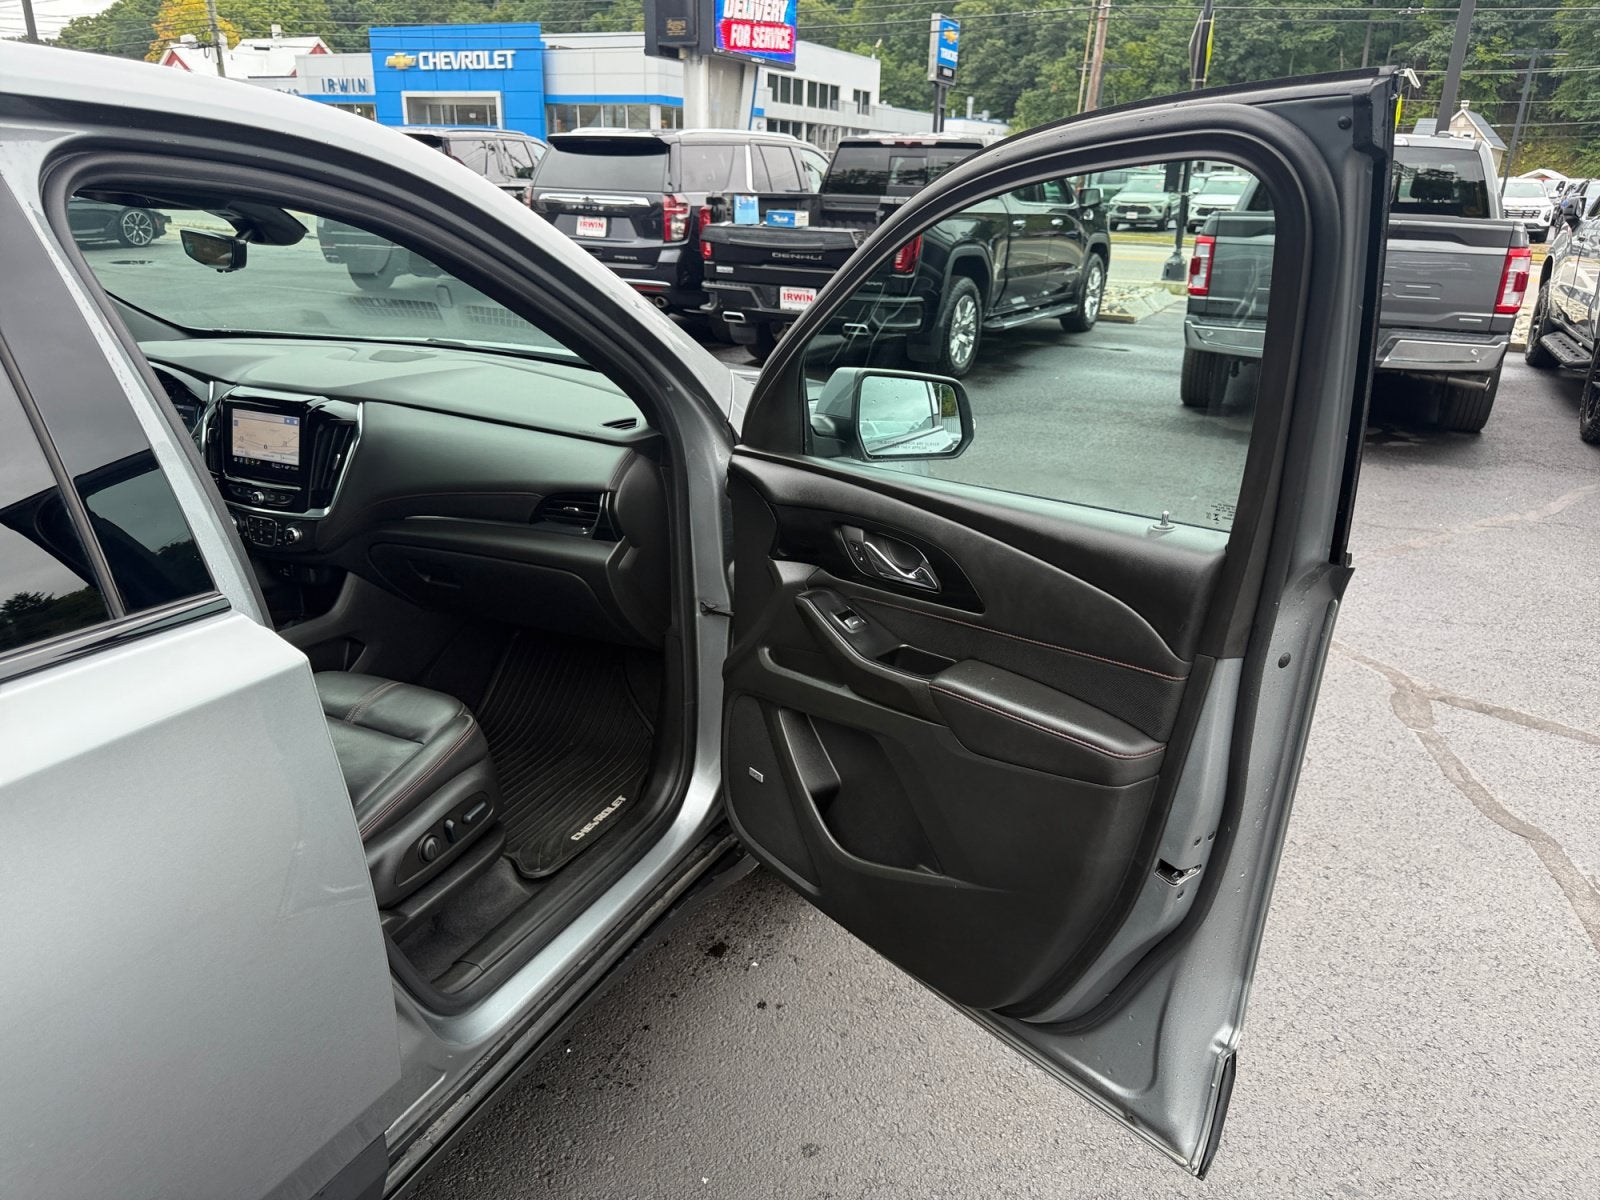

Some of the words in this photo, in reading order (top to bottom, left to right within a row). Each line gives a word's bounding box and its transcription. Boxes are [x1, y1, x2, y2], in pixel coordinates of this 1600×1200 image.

[723, 0, 789, 23] DELIVERY
[730, 23, 751, 47] FOR
[752, 26, 791, 50] SERVICE
[418, 50, 516, 71] CHEVROLET
[321, 78, 368, 93] IRWIN
[579, 220, 604, 229] IRWIN
[771, 252, 822, 261] DENALI
[783, 292, 813, 303] IRWIN
[570, 794, 627, 841] CHEVROLET
